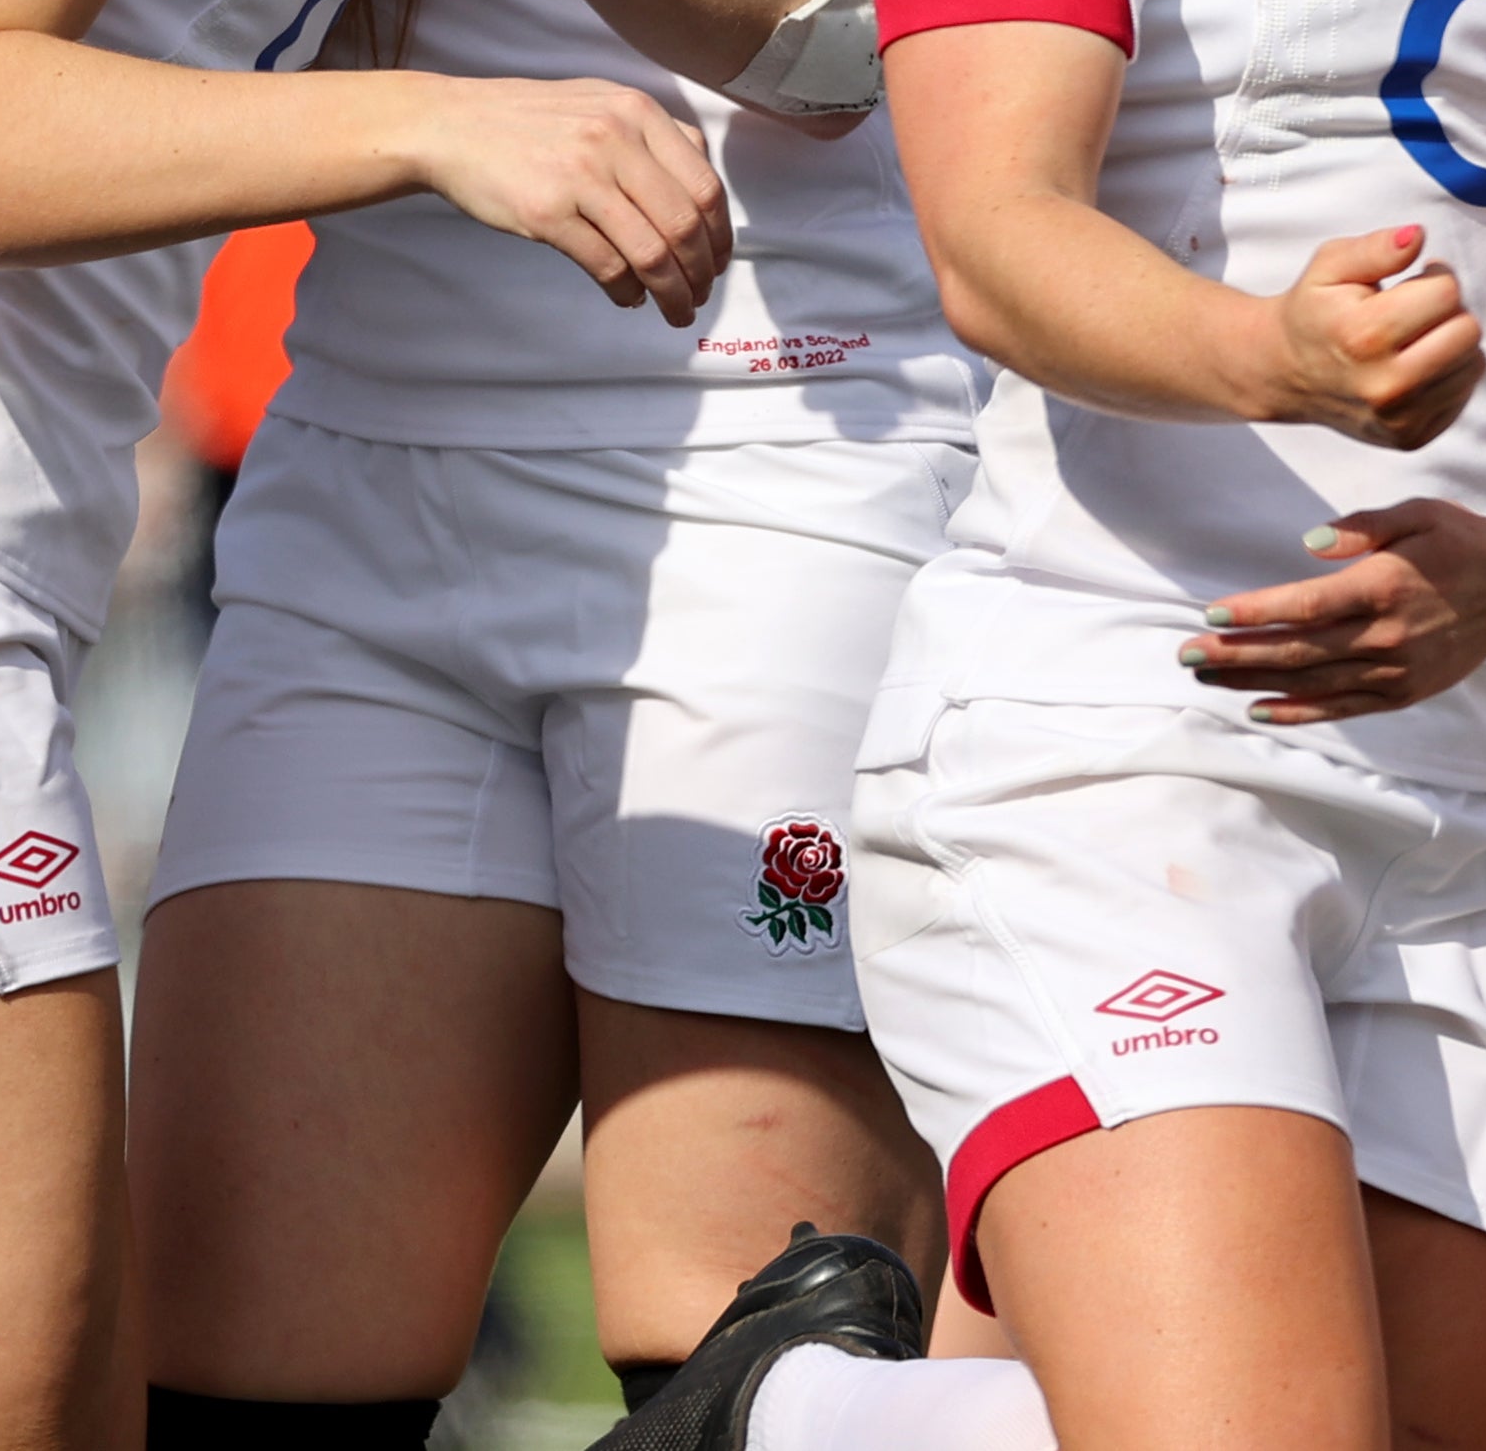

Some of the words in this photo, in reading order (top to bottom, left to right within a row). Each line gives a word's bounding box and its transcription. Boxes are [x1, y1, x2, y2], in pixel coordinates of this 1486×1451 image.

[697, 336, 779, 356] England
[781, 337, 804, 349] vs
[749, 348, 847, 373] 26.03.2022
[1111, 1026, 1219, 1057] umbro
